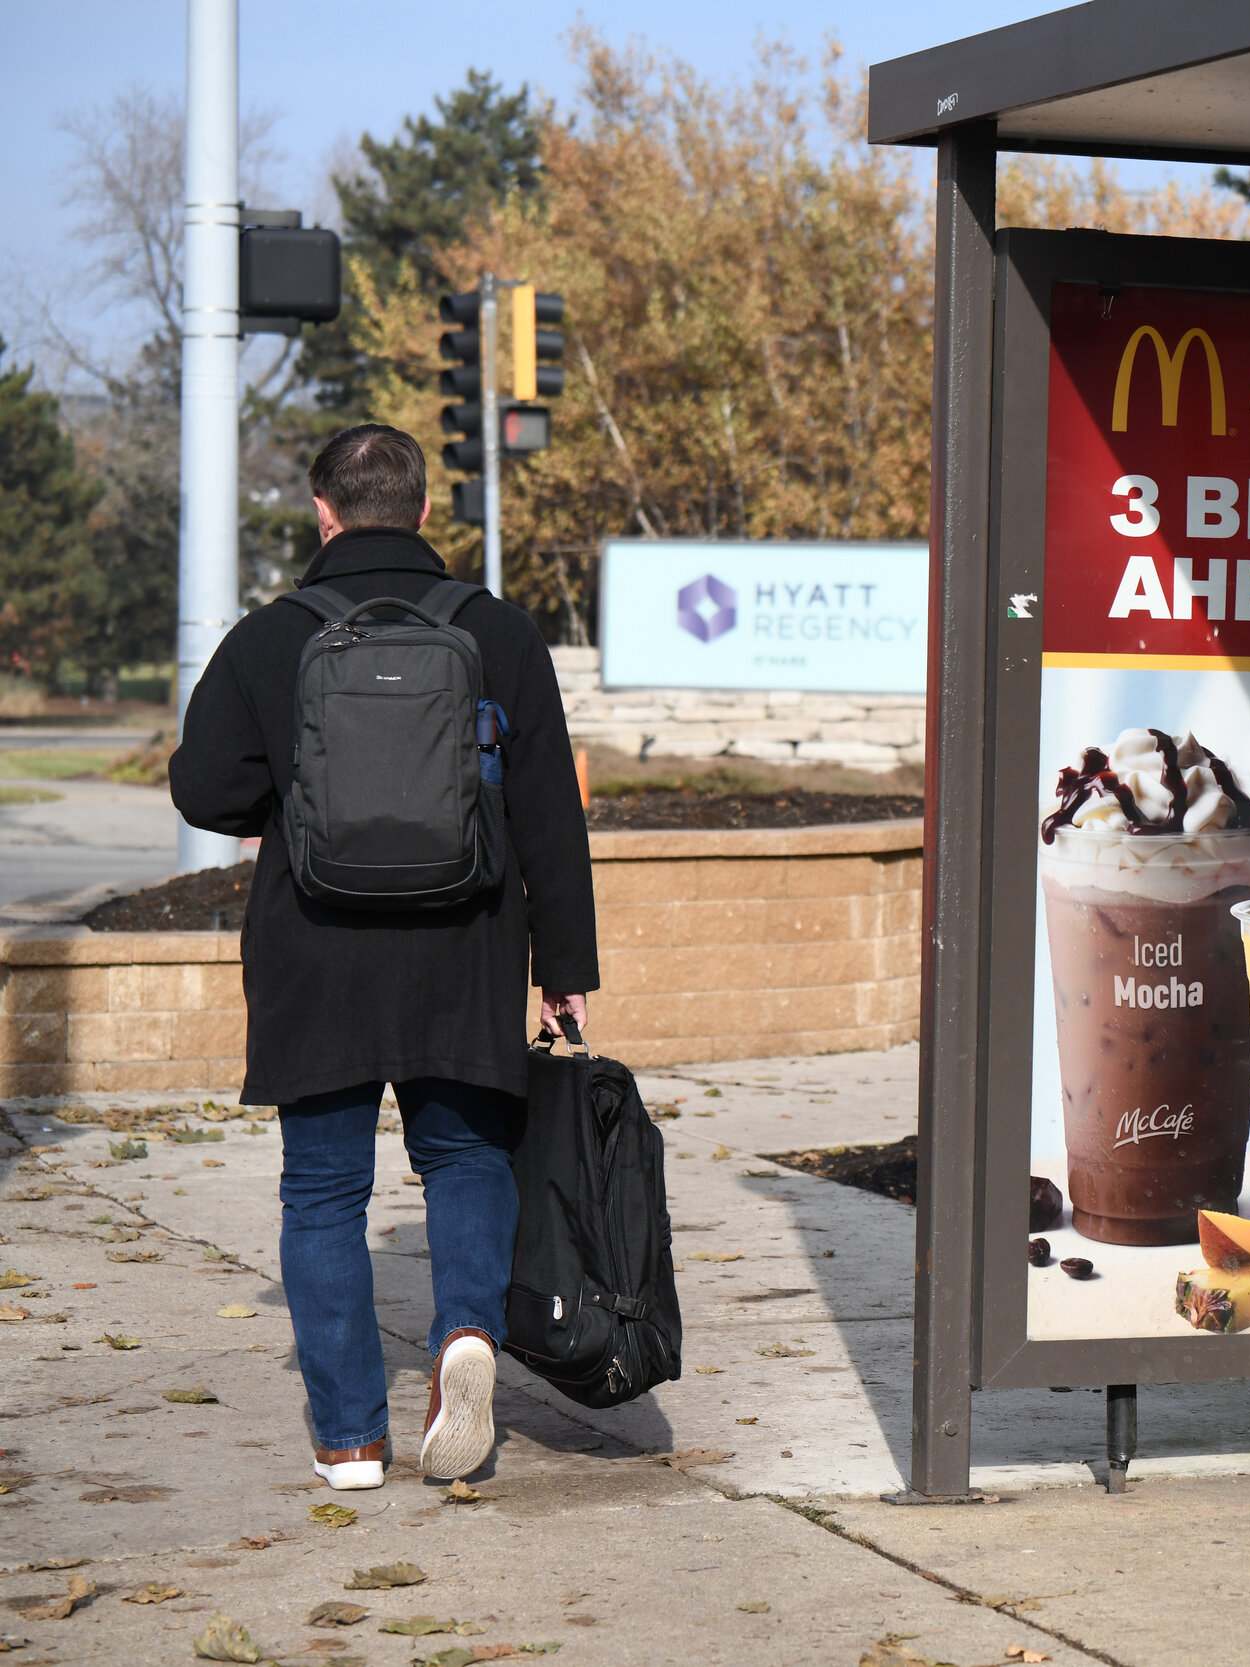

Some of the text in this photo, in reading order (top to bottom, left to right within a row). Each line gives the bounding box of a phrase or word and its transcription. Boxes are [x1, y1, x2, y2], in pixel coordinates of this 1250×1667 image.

[1109, 474, 1161, 539] 3
[755, 583, 878, 609] HYATT
[753, 613, 919, 642] REGENCY
[1133, 934, 1183, 967] Iced
[1114, 975, 1204, 1010] Mocha
[1113, 1103, 1195, 1150] McCafé
